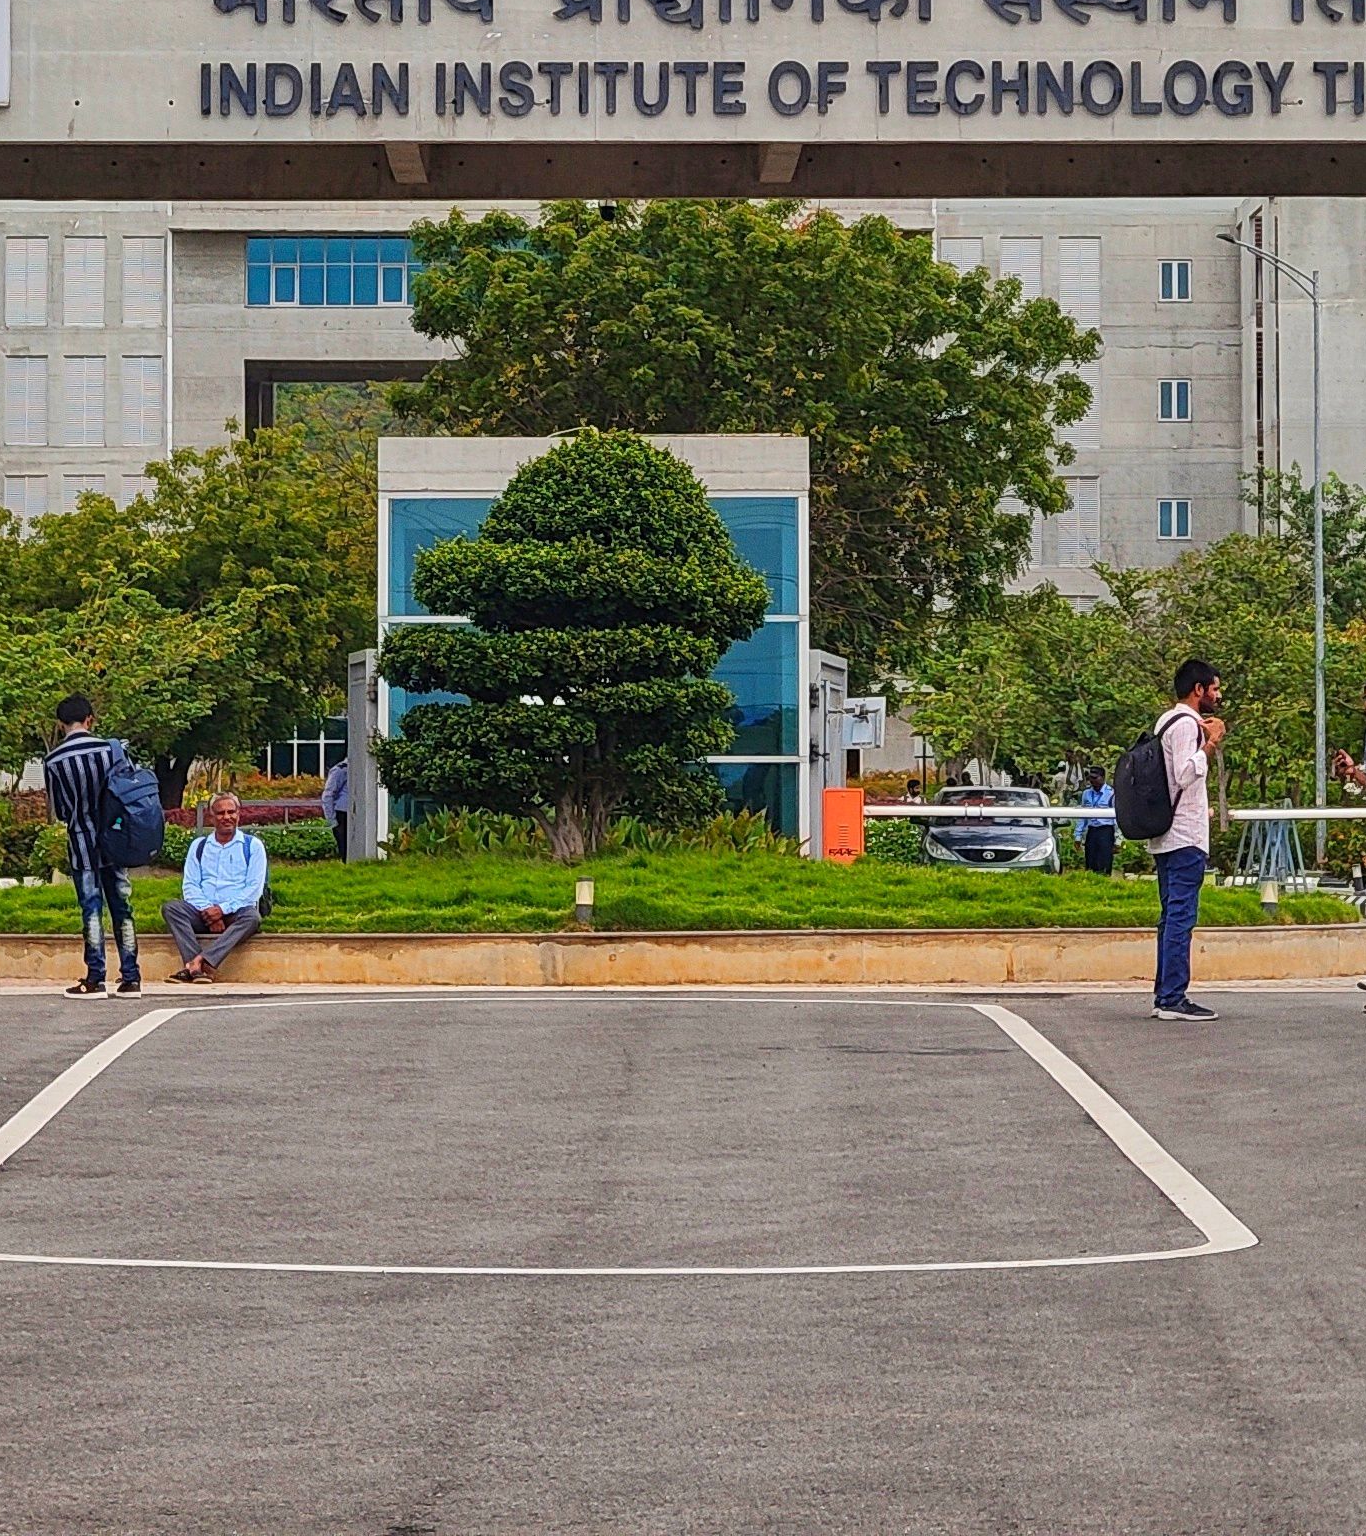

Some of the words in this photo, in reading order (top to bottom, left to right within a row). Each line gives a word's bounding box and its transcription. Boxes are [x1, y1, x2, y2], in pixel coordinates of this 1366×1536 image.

[201, 62, 409, 117] INDIAN
[436, 61, 746, 117] INSTITUTE
[768, 61, 849, 117] OF
[866, 60, 1294, 117] TECHNOLOGY
